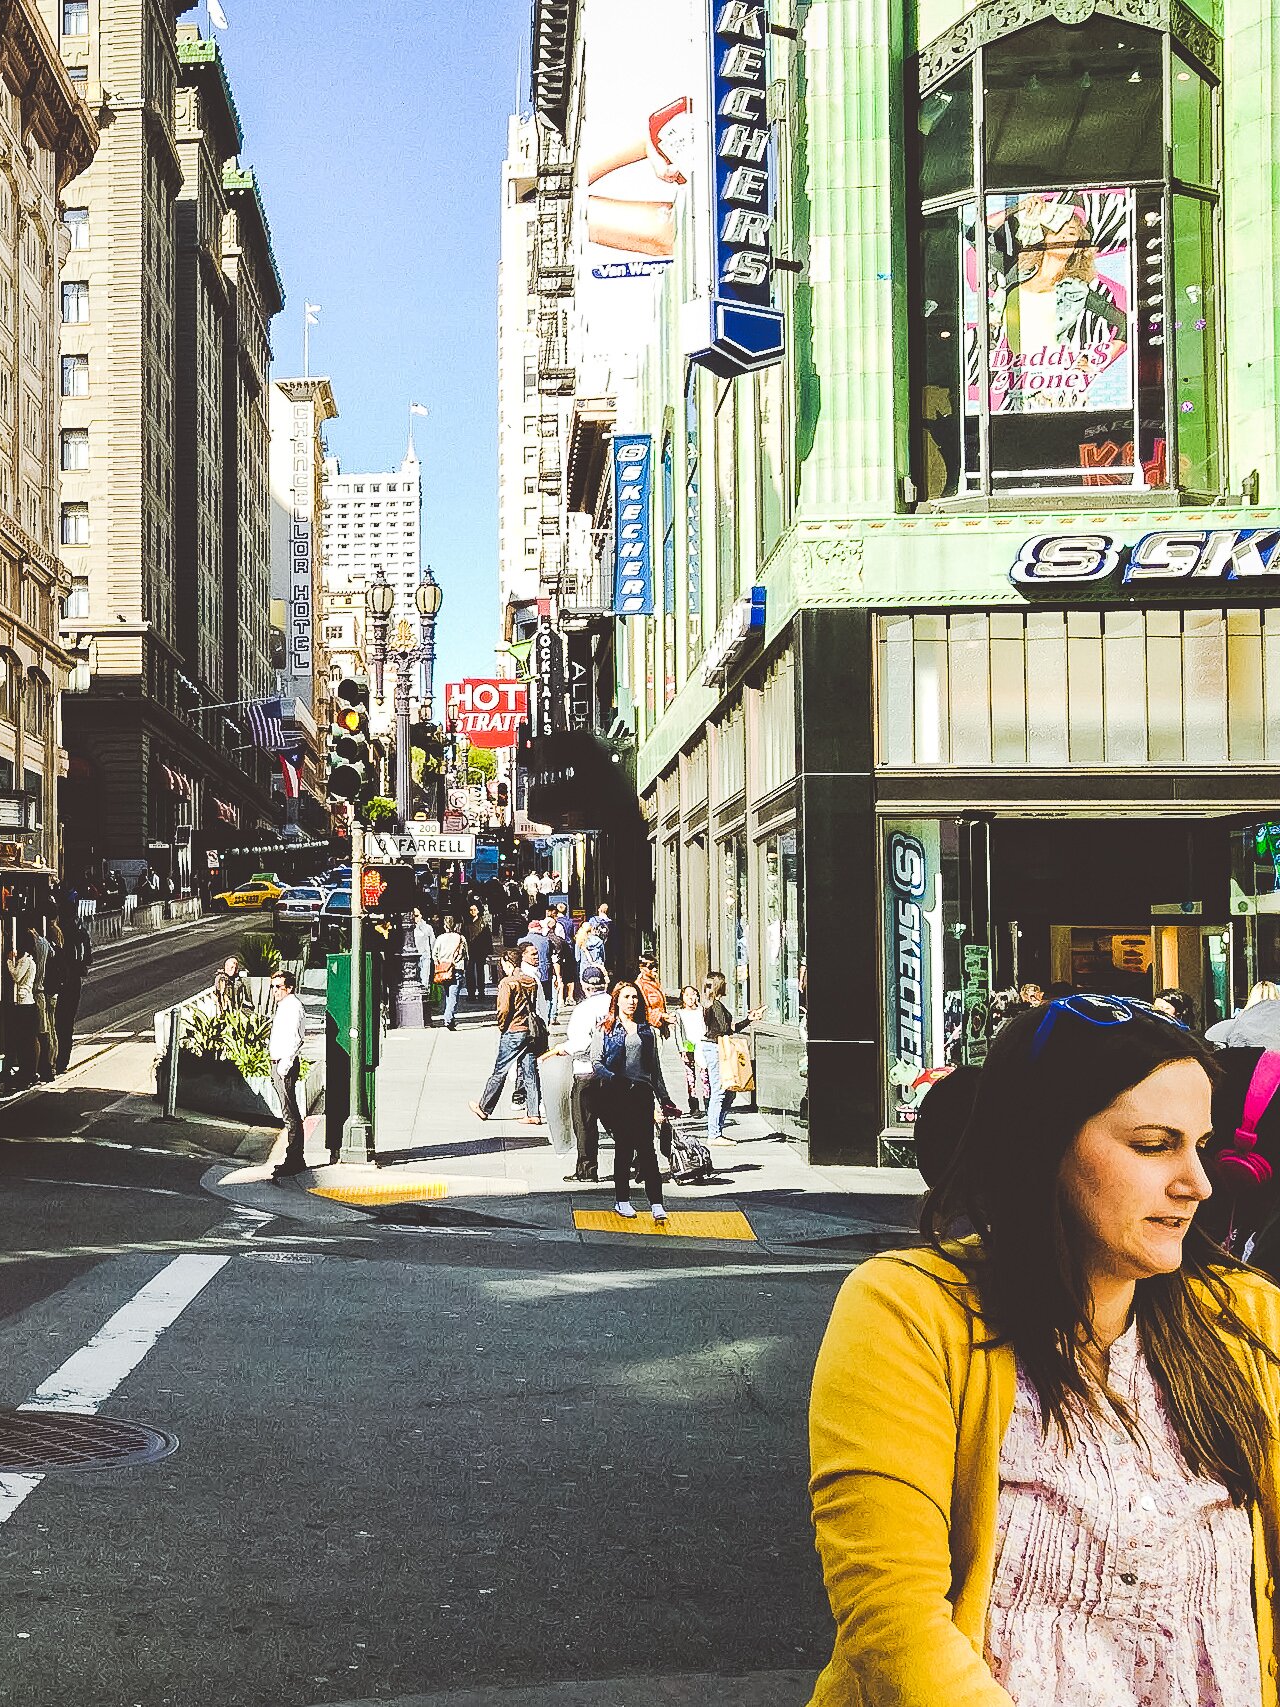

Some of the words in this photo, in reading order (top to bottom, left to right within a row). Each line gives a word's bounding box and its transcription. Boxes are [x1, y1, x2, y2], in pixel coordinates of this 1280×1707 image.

[993, 370, 1098, 394] Money
[293, 404, 309, 574] CHANCELLOR
[1123, 528, 1280, 583] SK
[293, 584, 310, 670] HOTEL
[451, 683, 527, 711] HOT
[539, 622, 552, 736] COCKTAILS
[379, 839, 465, 853] OFARRELL
[419, 824, 437, 833] 200
